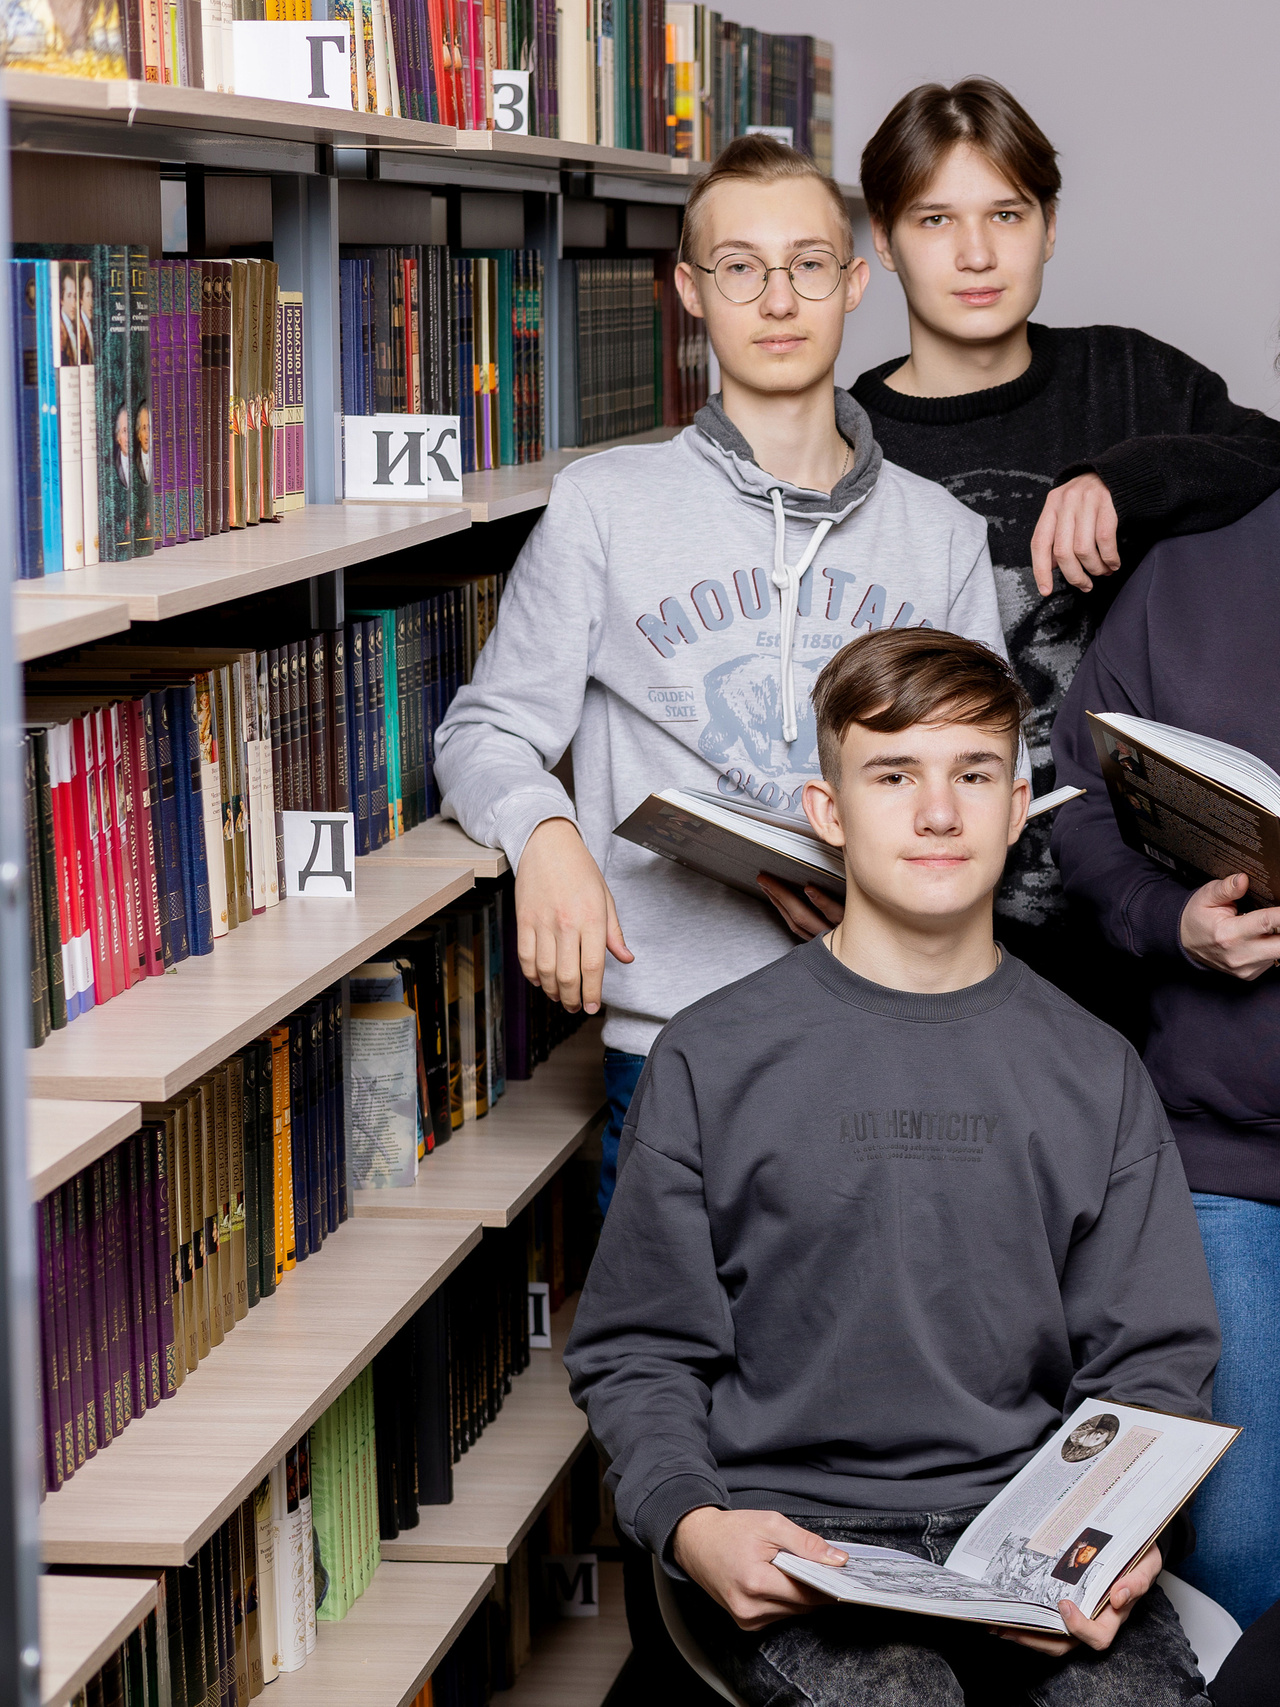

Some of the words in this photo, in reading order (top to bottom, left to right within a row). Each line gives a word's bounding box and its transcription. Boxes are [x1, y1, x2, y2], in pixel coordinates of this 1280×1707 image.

[306, 36, 345, 98] Г
[493, 83, 524, 131] З
[373, 431, 425, 485] И
[428, 428, 459, 482] К
[636, 567, 934, 659] MOUTAI
[801, 633, 844, 650] 1850
[647, 689, 694, 703] GOLDEN
[665, 705, 696, 718] STATE
[139, 736, 147, 771] ГАВРОШ
[357, 729, 364, 741] де
[337, 746, 345, 785] ДАНТЕ
[299, 820, 352, 891] Д
[151, 873, 161, 936] ВИКТОР
[839, 1109, 999, 1144] AUTHENTICITY
[223, 1292, 232, 1305] 10
[237, 1280, 246, 1293] 10
[546, 1562, 596, 1605] М
